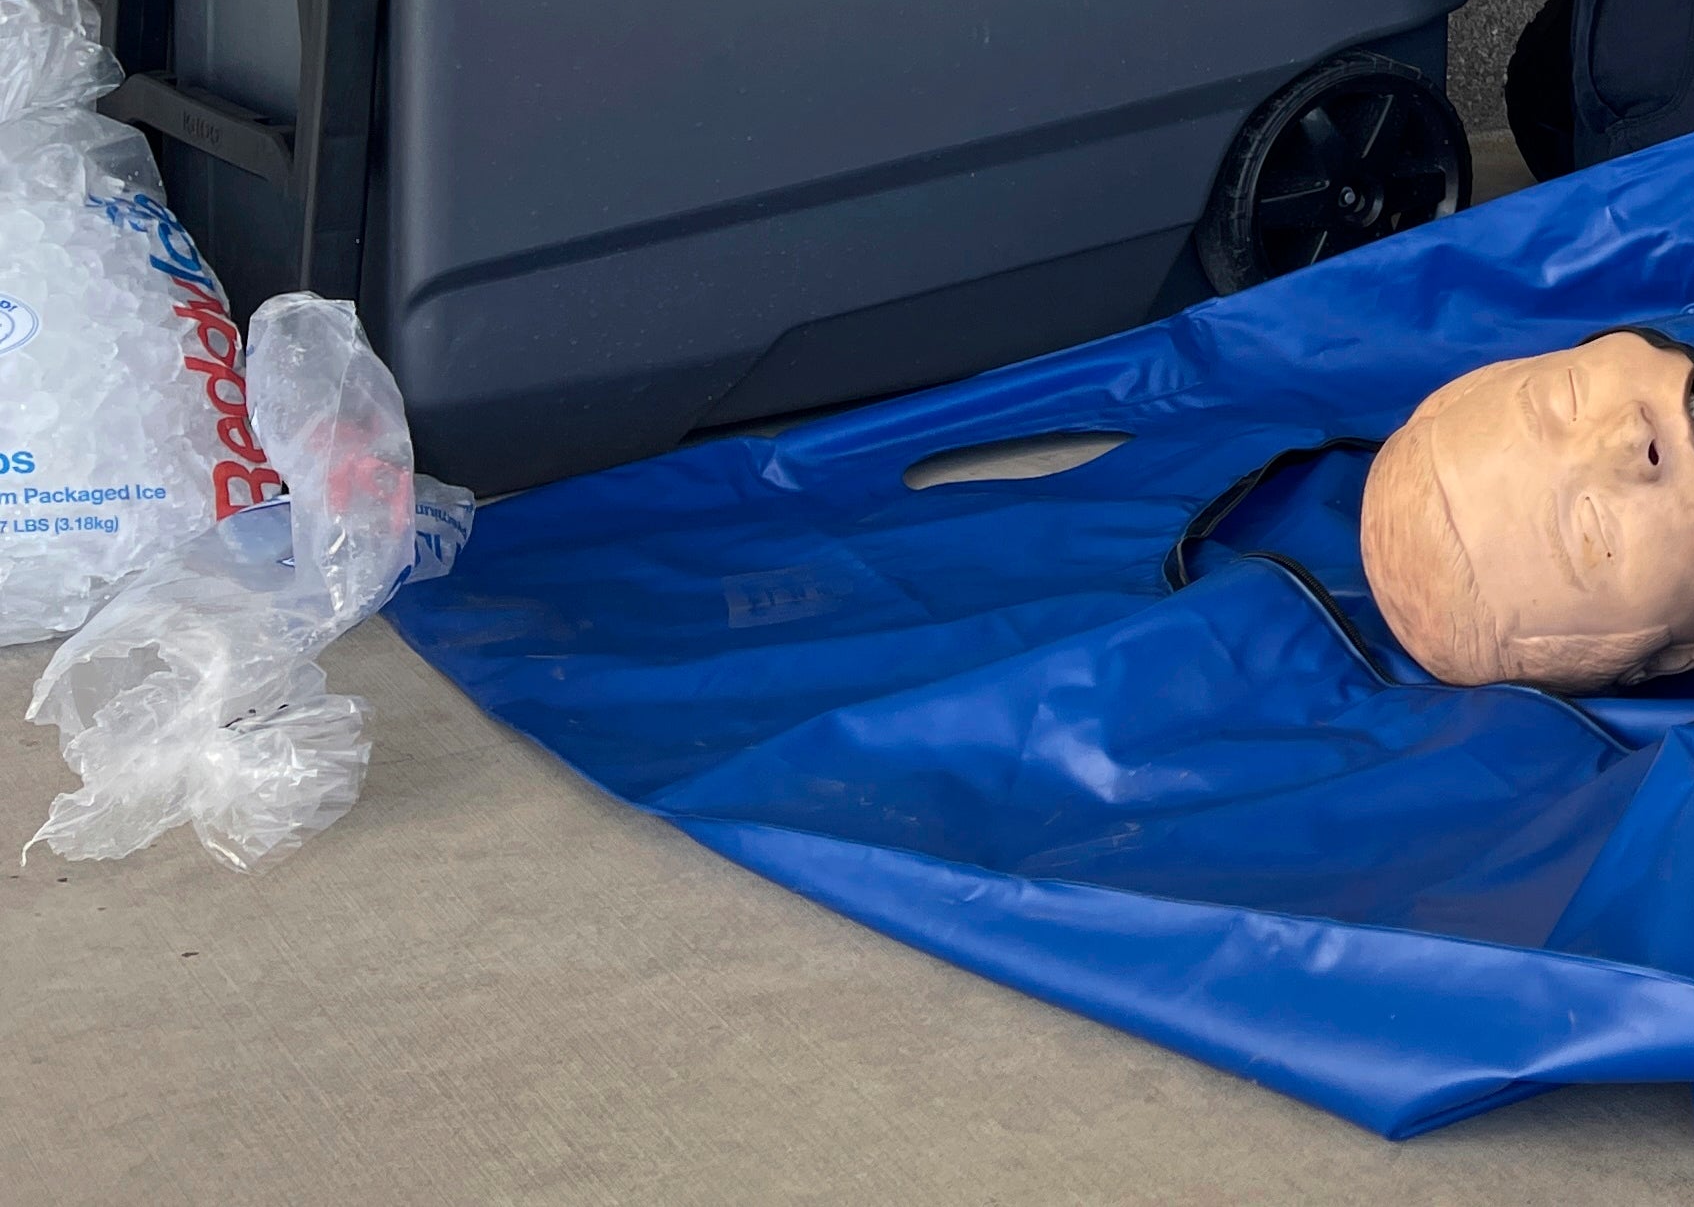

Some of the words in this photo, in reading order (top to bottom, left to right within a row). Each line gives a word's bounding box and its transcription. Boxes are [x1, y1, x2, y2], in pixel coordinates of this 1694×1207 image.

[24, 484, 130, 505] Packaged
[135, 484, 167, 500] Ice
[14, 518, 50, 533] LBS
[54, 514, 119, 535] (3.18kg)
